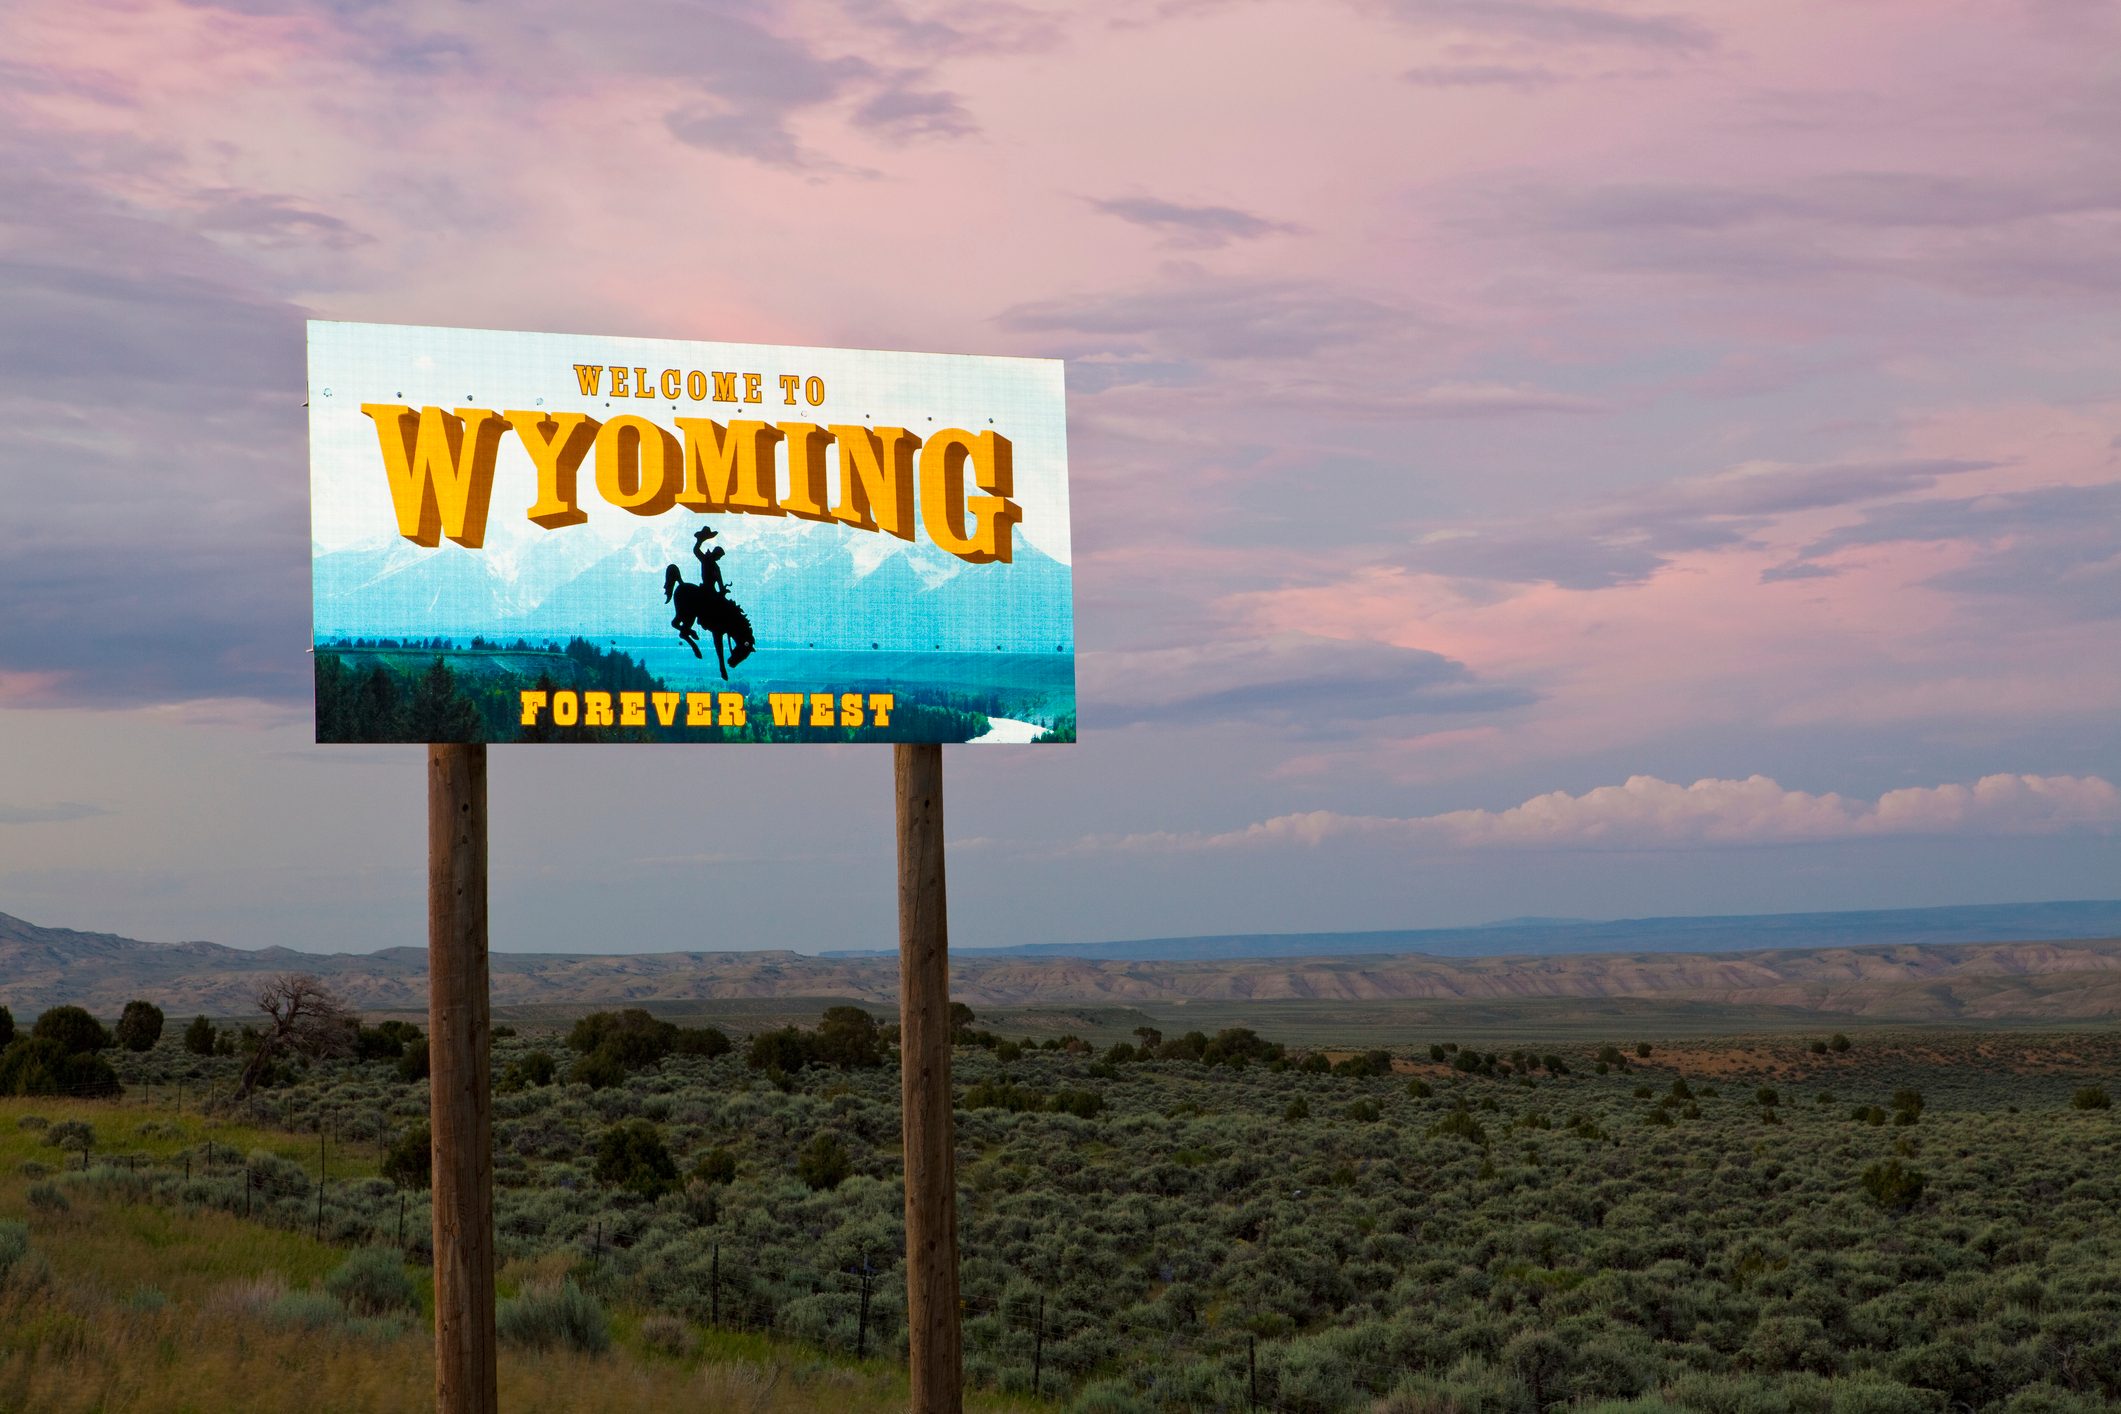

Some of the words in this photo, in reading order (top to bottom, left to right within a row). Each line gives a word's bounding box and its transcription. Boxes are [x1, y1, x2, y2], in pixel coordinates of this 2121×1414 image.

[573, 363, 763, 404] WELCOME
[779, 374, 826, 406] TO
[360, 402, 1023, 564] WYOMING
[520, 690, 747, 727] FOREVER
[769, 692, 895, 728] WEST
